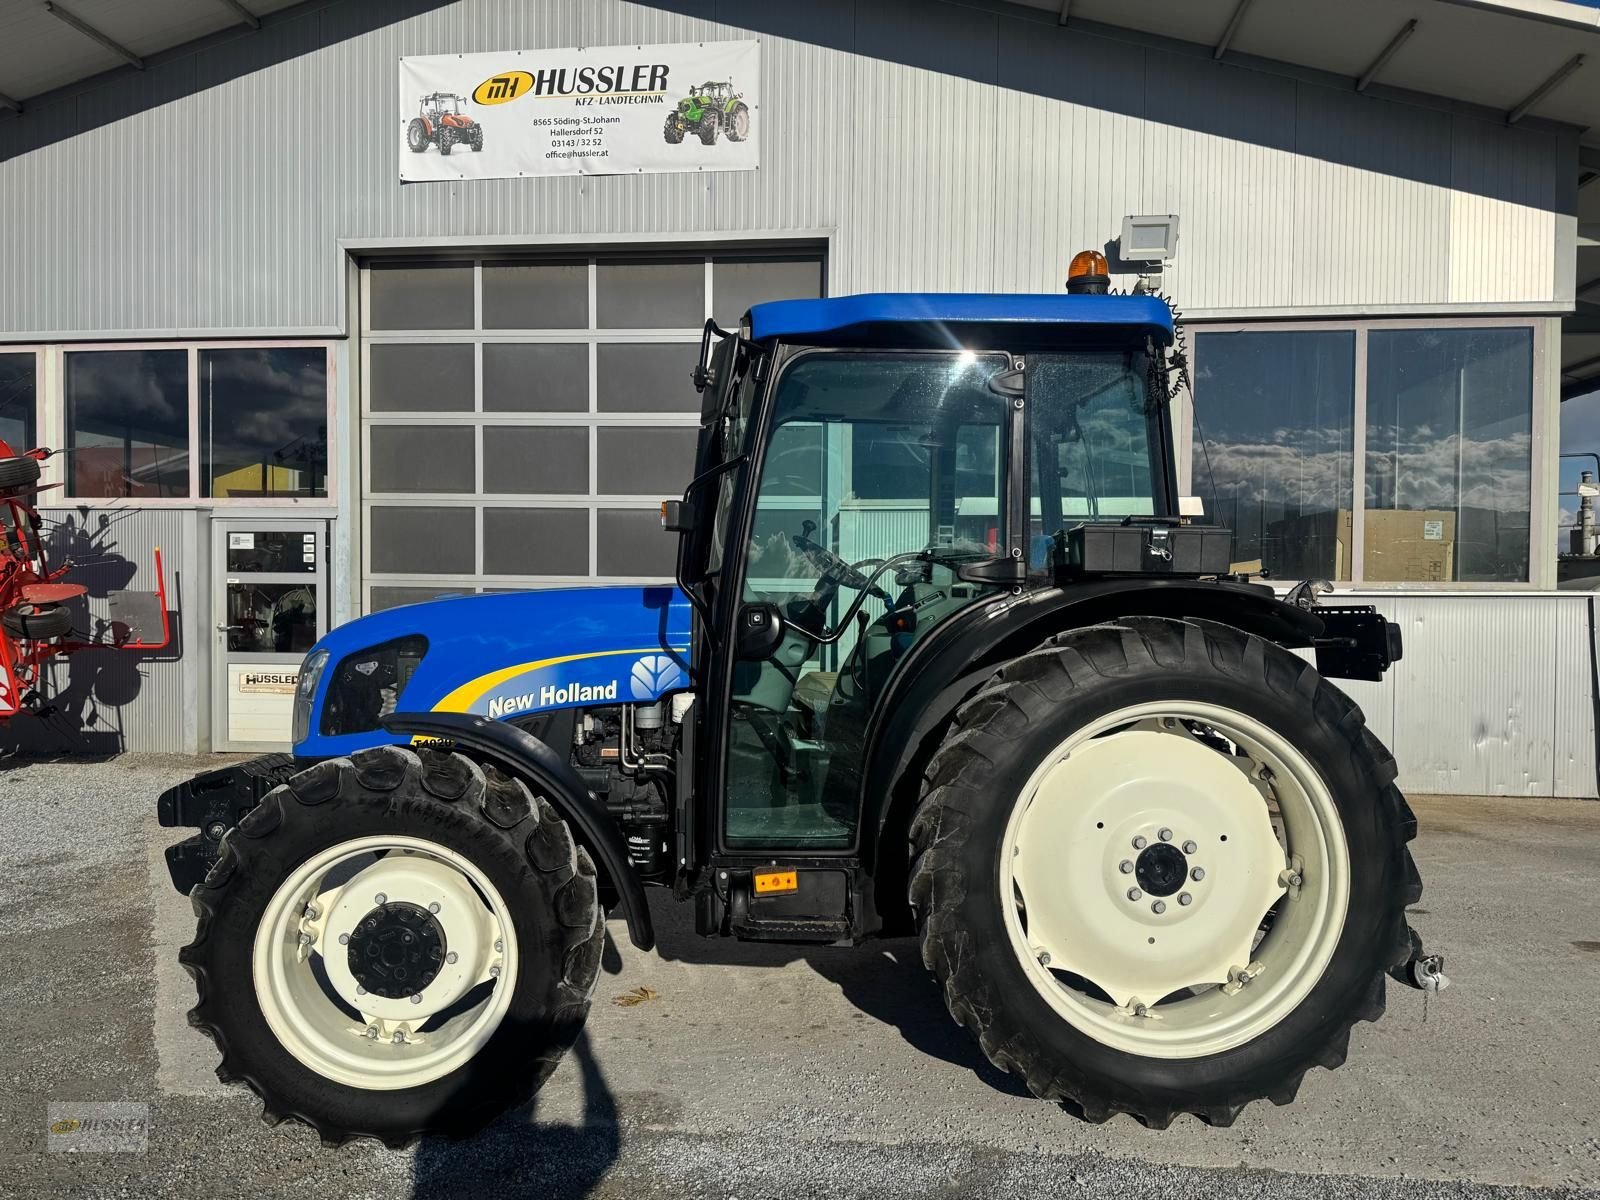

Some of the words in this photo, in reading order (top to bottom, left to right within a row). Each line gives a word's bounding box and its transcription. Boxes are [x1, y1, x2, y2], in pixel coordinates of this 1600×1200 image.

[535, 64, 670, 96] HUSSLER
[599, 95, 664, 105] LANDTECHNIK
[533, 118, 552, 126] 8565
[553, 116, 621, 126] Söding-St.Johann
[550, 128, 592, 136] Hallersdorf
[545, 150, 608, 159] office@hussler.at
[488, 694, 534, 718] New
[540, 680, 617, 706] Holland
